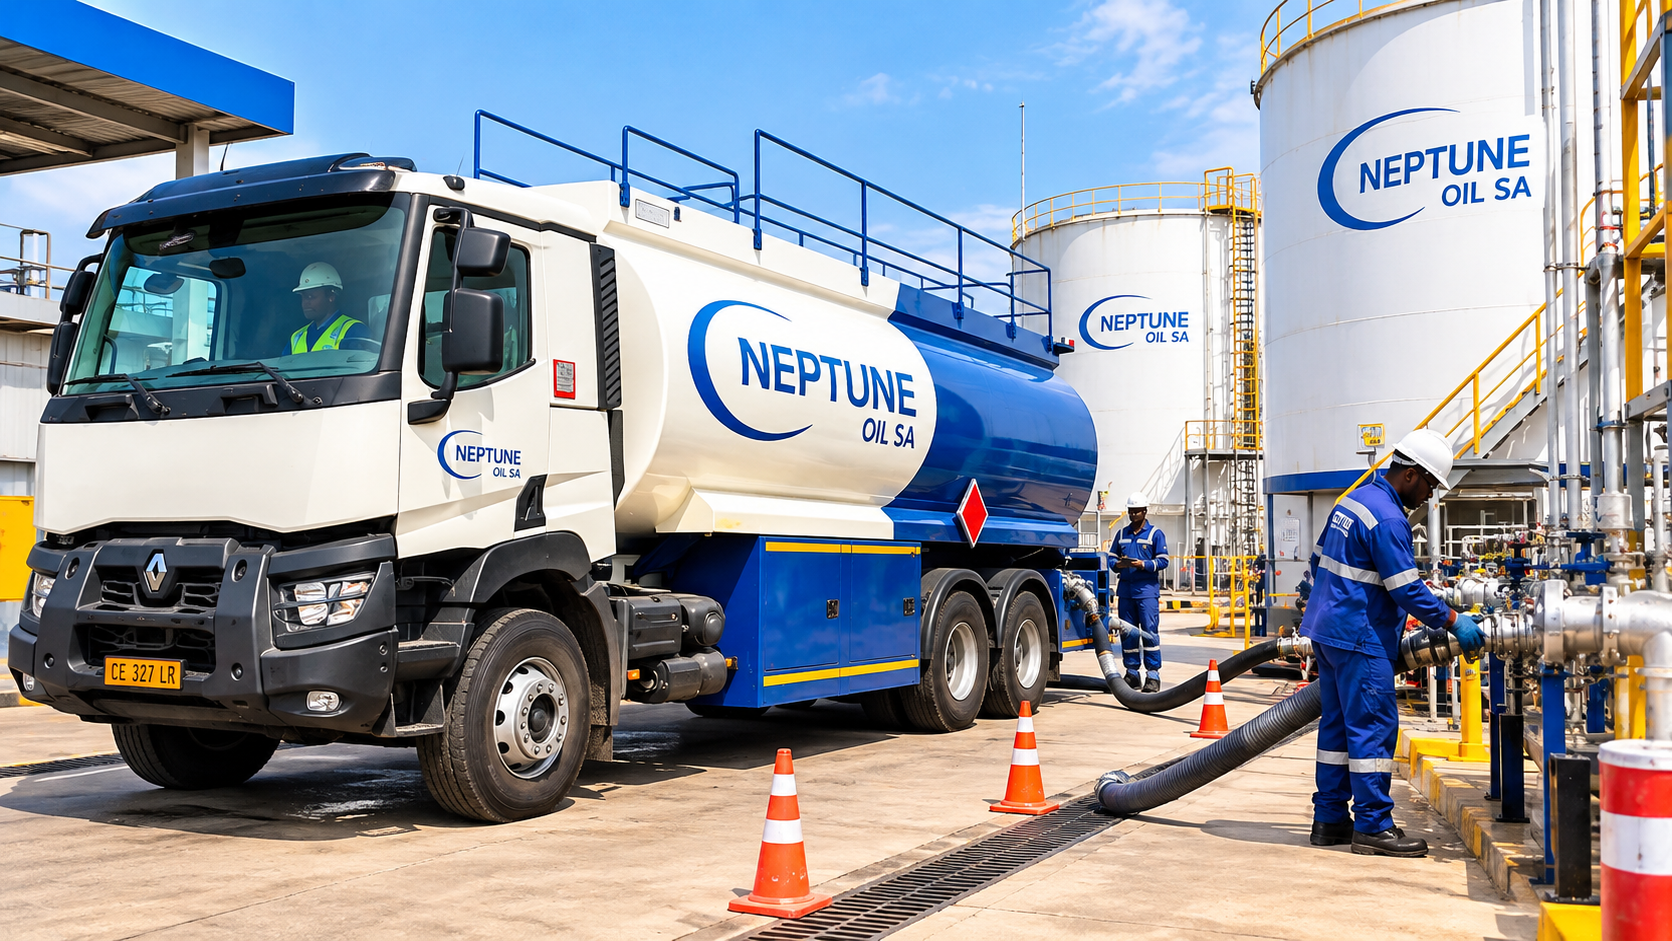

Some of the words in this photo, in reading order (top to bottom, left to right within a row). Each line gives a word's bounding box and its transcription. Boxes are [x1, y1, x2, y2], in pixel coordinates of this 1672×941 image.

[1359, 134, 1531, 195] NEPTUNE
[1442, 182, 1485, 207] OIL
[1494, 175, 1532, 201] SA
[1100, 311, 1189, 333] NEPTUNE
[1145, 331, 1167, 344] OIL
[1171, 330, 1189, 343] SA
[737, 336, 917, 418] NEPTUNE
[861, 417, 889, 445] OIL
[893, 423, 915, 448] SA
[455, 444, 522, 466] NEPTUNE
[492, 466, 507, 478] OIL
[509, 468, 521, 479] SA
[111, 662, 127, 681] CE
[132, 663, 155, 683] 327
[159, 665, 175, 685] LR
